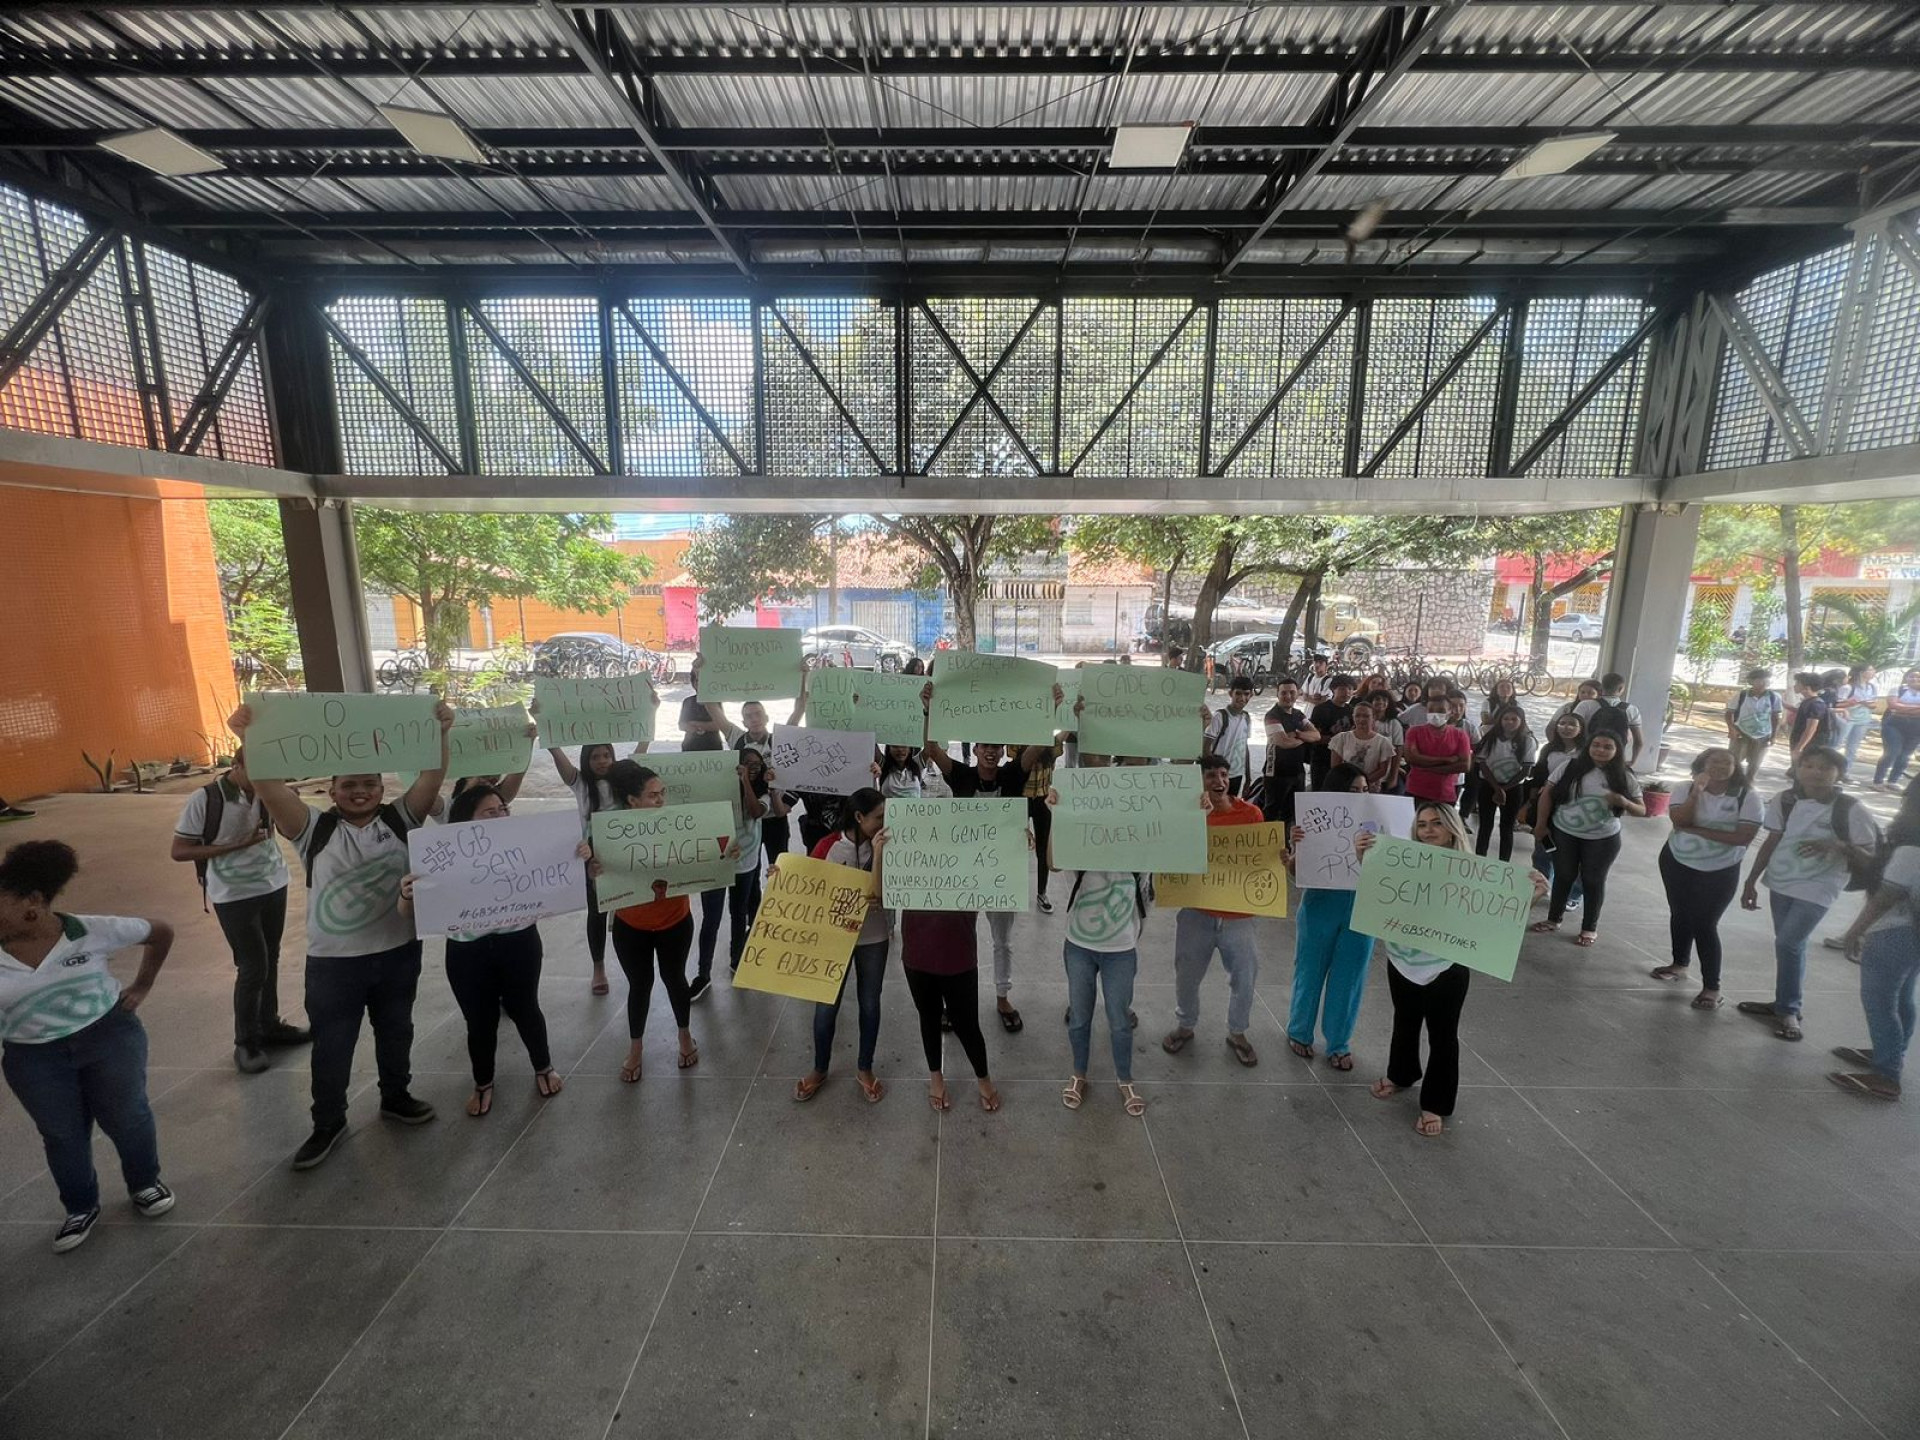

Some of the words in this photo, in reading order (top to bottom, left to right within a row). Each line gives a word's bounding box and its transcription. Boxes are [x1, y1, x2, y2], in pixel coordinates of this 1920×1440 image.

[323, 699, 346, 728] O
[1151, 772, 1191, 789] FAZ
[1120, 794, 1163, 812] SEM
[890, 826, 917, 845] VER
[929, 826, 939, 842] A
[1235, 827, 1278, 848] AULA
[885, 850, 959, 869] OCUPANDO
[1385, 845, 1433, 870] SEM
[1441, 854, 1514, 890] TONER
[773, 871, 827, 896] NOSSA
[1378, 876, 1431, 906] SEM
[923, 892, 943, 908] AS
[752, 920, 819, 947] PRECISA
[777, 951, 845, 982] AJUSTES
